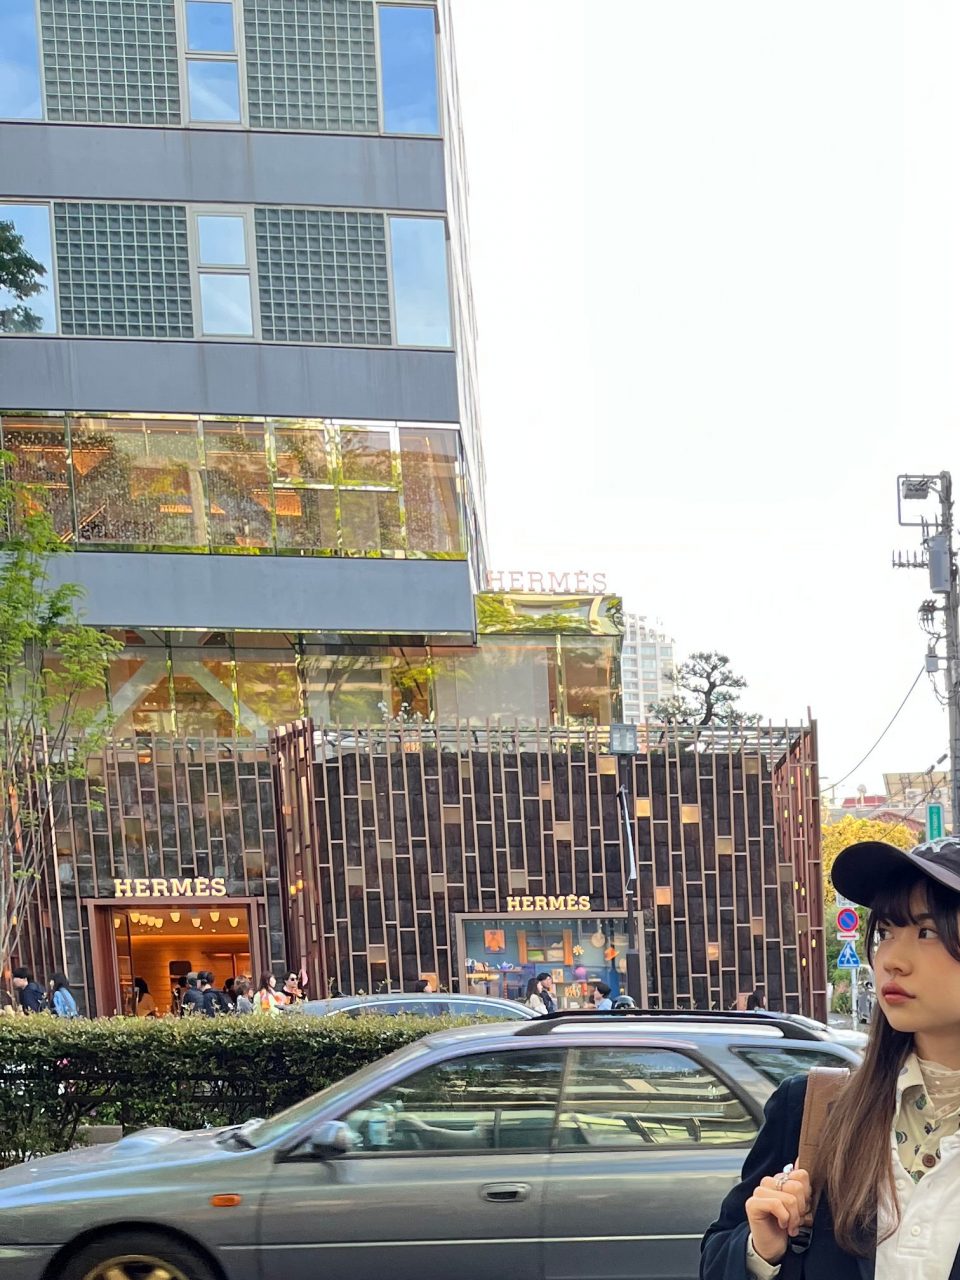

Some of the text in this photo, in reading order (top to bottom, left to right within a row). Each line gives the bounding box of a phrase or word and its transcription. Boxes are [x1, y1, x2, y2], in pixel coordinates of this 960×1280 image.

[486, 570, 608, 593] HERMÈS
[113, 876, 227, 897] HERMÈS
[506, 893, 591, 911] HERMÈS
